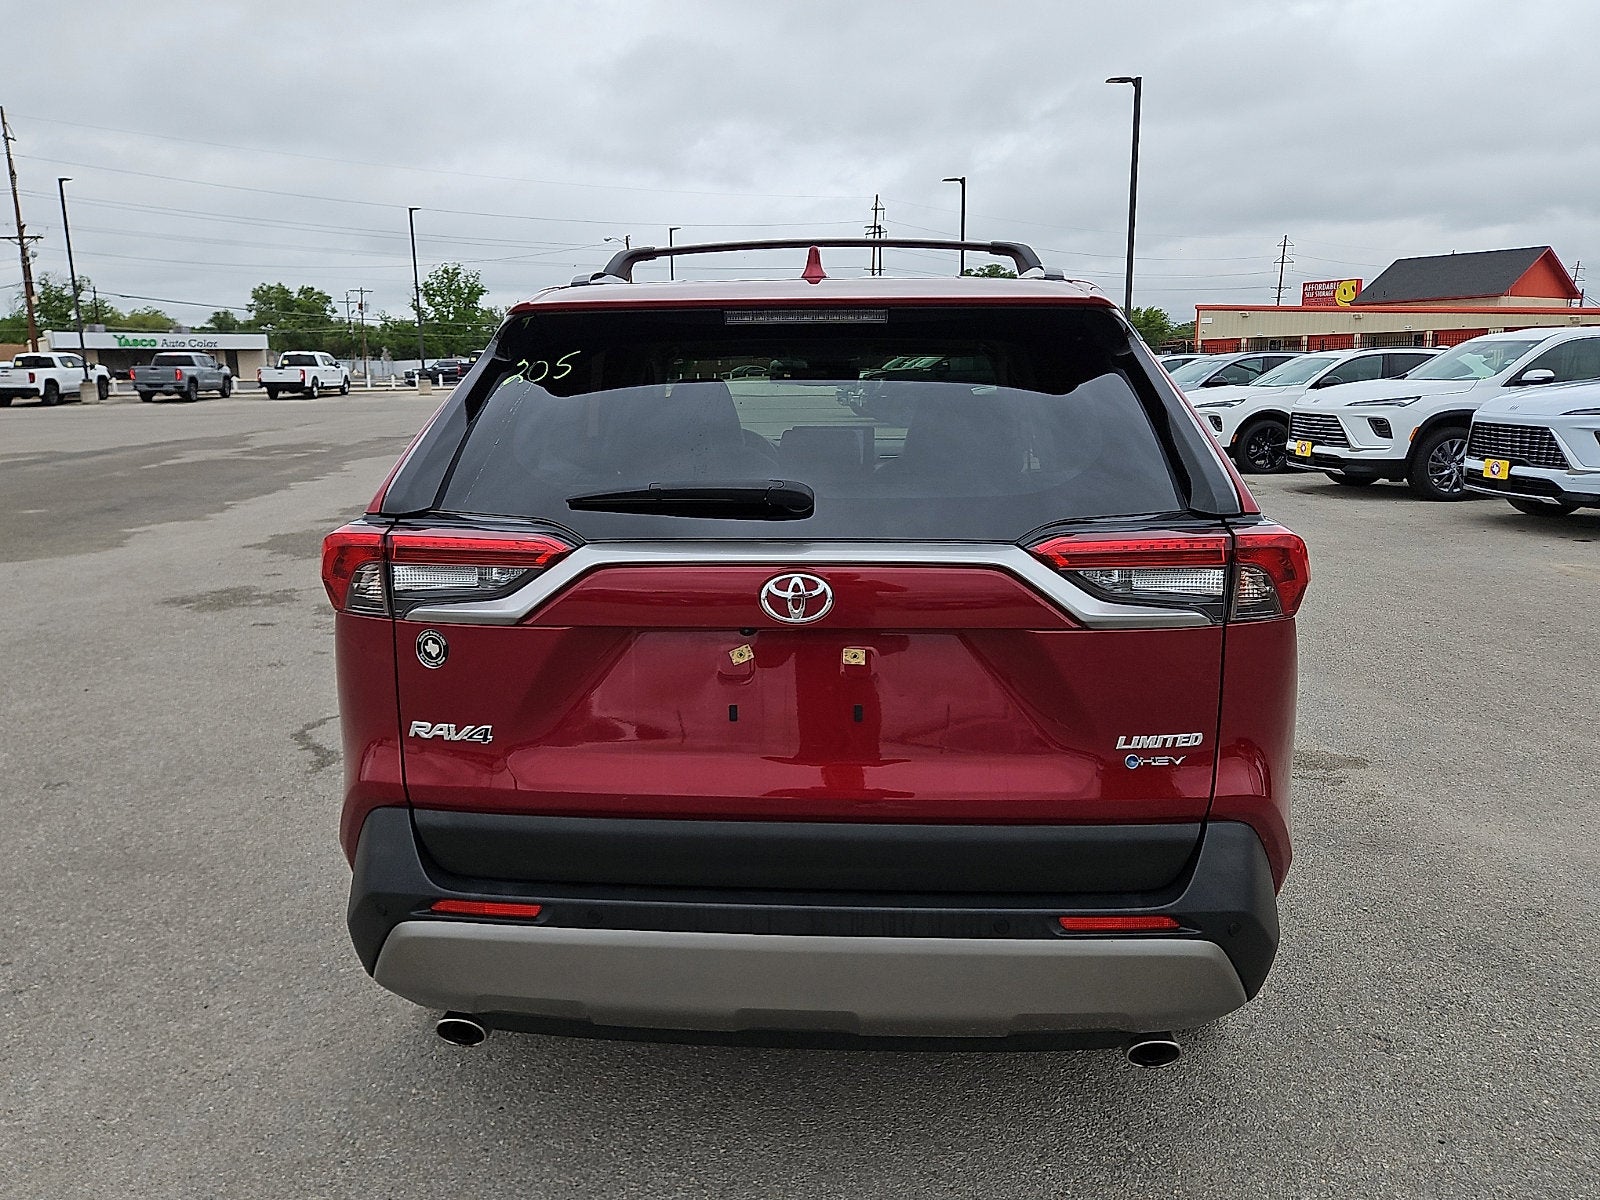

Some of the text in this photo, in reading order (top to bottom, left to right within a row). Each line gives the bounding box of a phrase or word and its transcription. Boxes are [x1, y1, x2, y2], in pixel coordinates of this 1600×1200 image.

[1304, 282, 1341, 291] AFFORDABLE
[161, 339, 186, 348] Auto
[188, 339, 218, 348] Color
[502, 350, 581, 387] 205
[408, 720, 494, 744] RAV4
[1115, 732, 1204, 750] LIMITED
